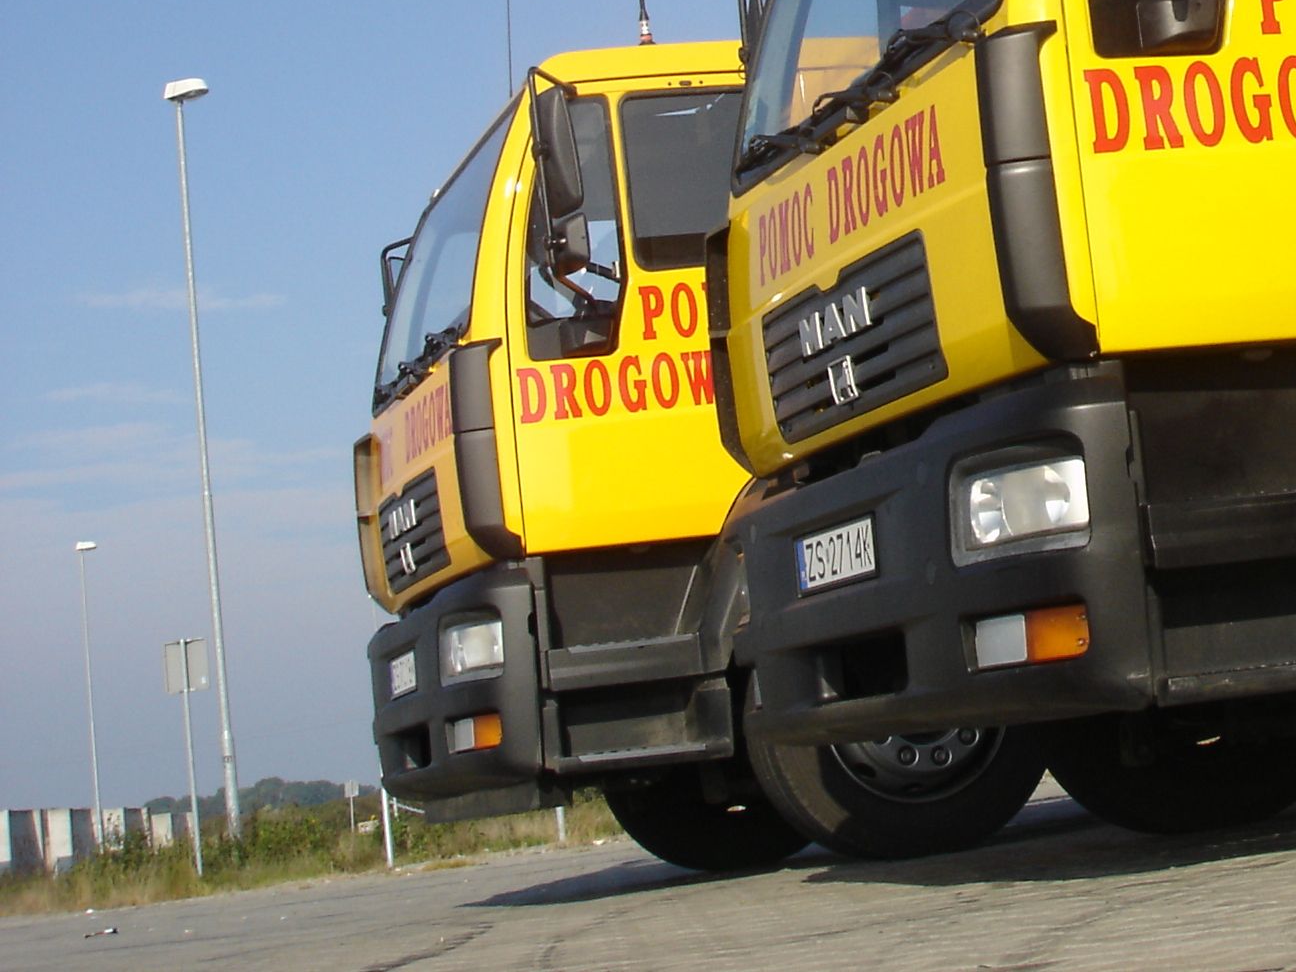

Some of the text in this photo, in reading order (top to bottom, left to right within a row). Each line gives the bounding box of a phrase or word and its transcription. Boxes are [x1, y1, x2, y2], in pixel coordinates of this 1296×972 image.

[758, 104, 945, 287] POMOC DROGOWA
[638, 282, 707, 340] PO
[799, 286, 872, 356] MAN
[405, 382, 452, 464] DROGOWA
[516, 350, 715, 424] DROGOW
[805, 524, 872, 583] ZS 2714K
